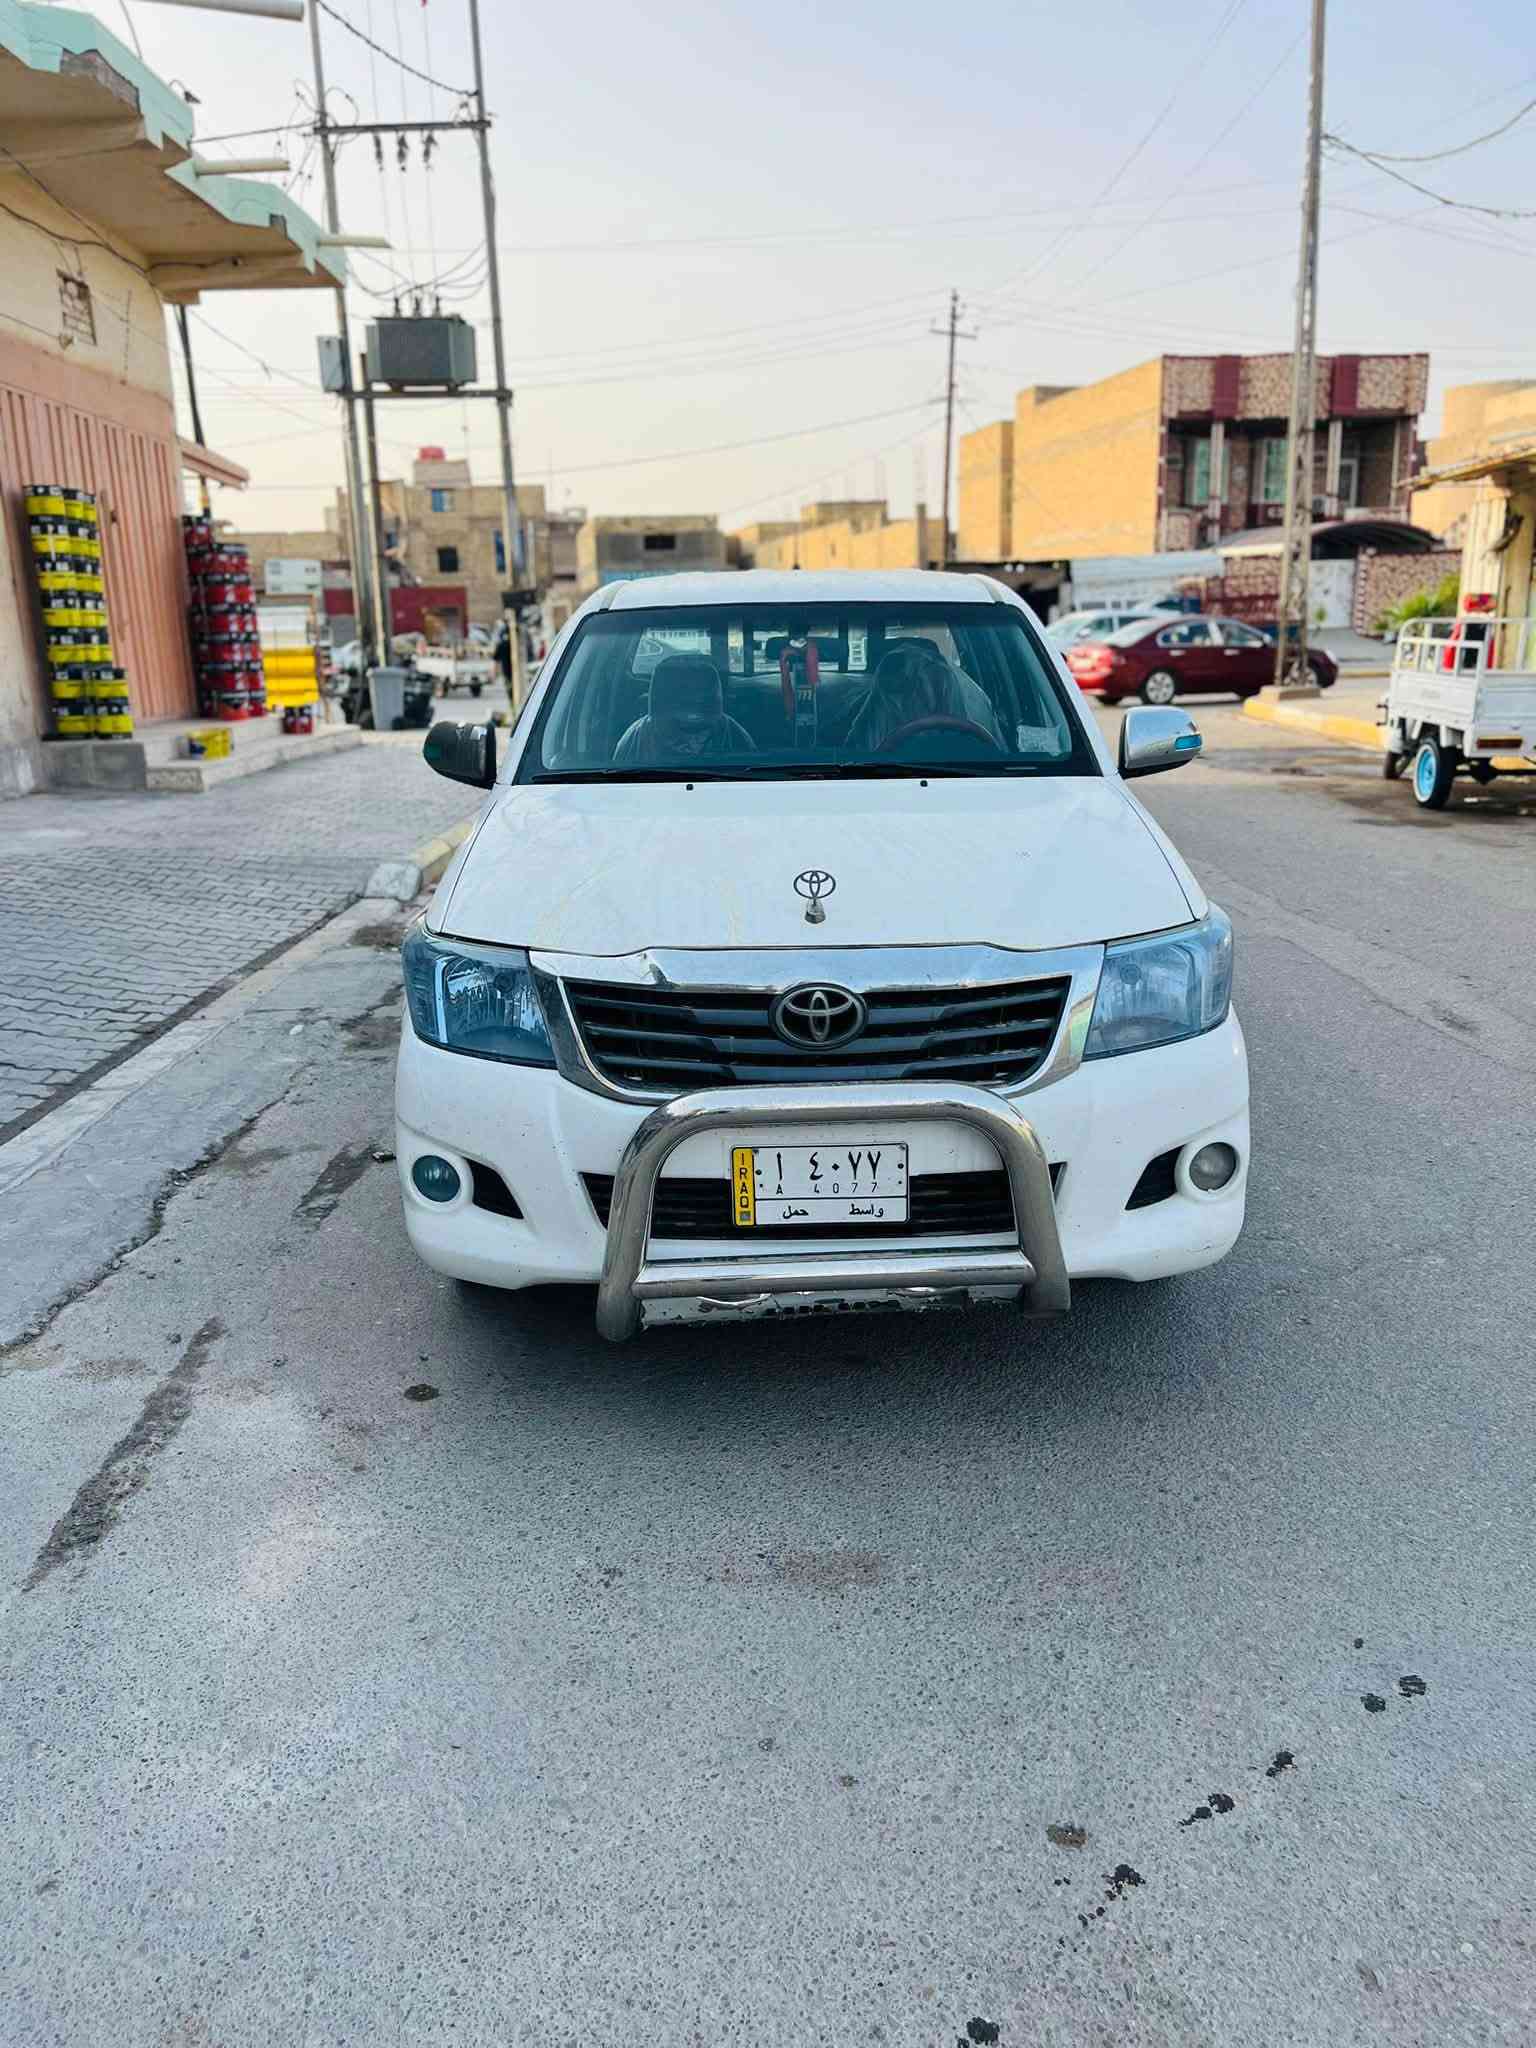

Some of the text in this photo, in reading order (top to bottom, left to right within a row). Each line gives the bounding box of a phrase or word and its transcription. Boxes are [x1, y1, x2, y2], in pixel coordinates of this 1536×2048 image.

[739, 1151, 749, 1209] IRAQ
[813, 1181, 878, 1194] 4077
[782, 1203, 884, 1219] واسط حمل
